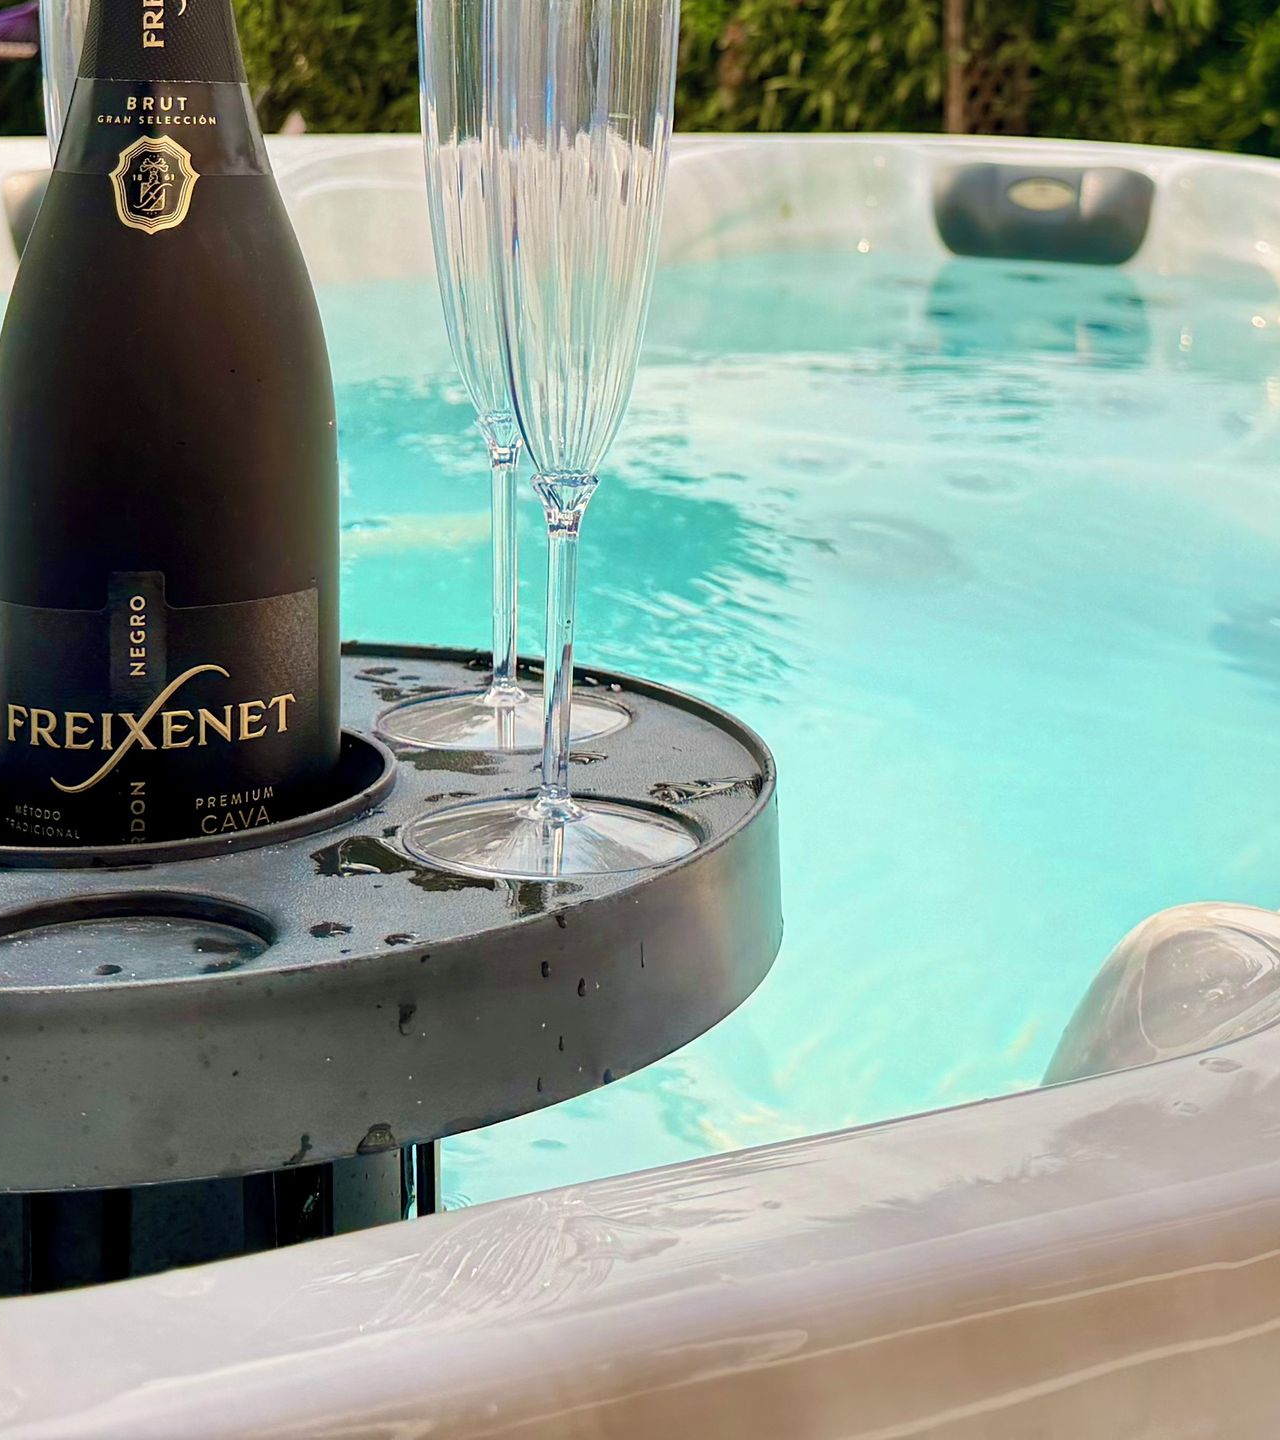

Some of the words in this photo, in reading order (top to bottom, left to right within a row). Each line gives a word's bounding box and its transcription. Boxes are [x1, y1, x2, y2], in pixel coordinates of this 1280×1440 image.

[127, 96, 188, 111] BRUT
[97, 115, 132, 124] GRAN
[138, 114, 217, 125] SELECCIÓN
[130, 595, 146, 676] NEGRO
[7, 664, 297, 793] FREIXENET
[195, 785, 274, 810] PREMIUM
[5, 817, 81, 840] TRADICIONAL
[200, 805, 271, 835] CAVA
